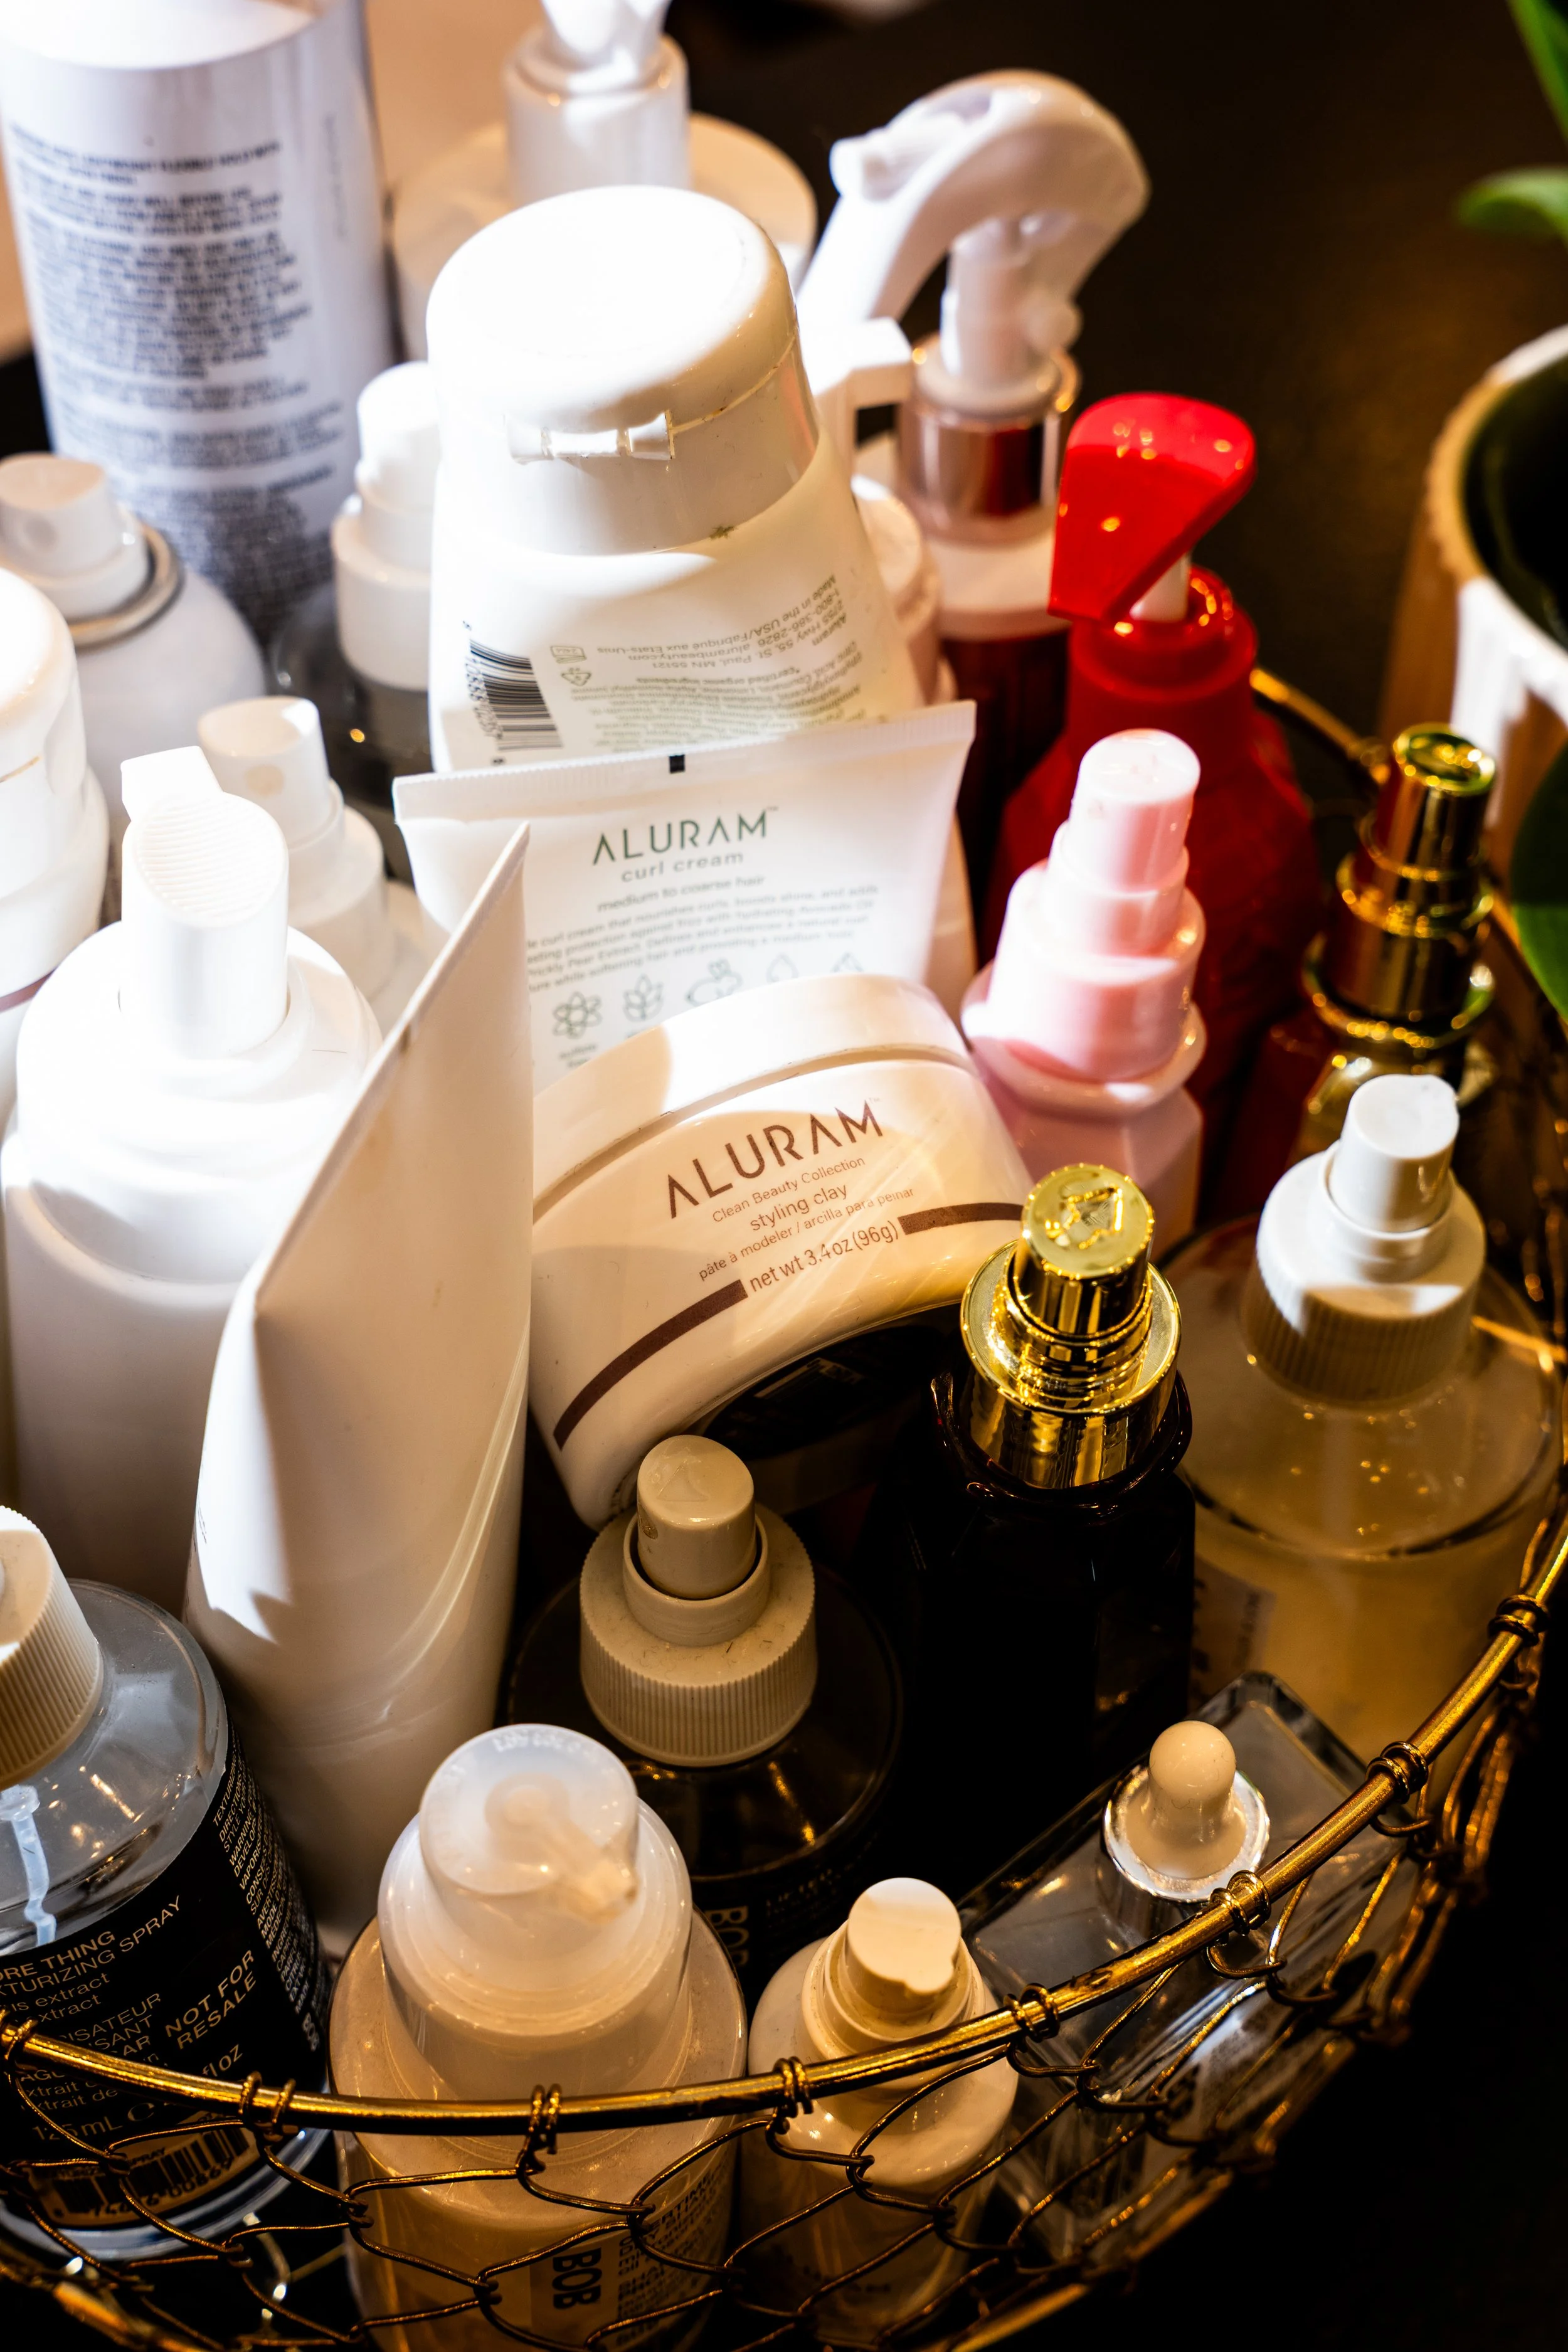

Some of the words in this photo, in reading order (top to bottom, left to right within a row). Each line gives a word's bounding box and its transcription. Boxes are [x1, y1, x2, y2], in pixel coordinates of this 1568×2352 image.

[801, 598, 812, 609] in
[812, 575, 835, 600] Made
[782, 607, 800, 622] the
[812, 613, 847, 646] Aluram
[621, 861, 664, 882] curl
[673, 852, 744, 872] cream
[597, 890, 659, 913] medium
[661, 886, 678, 898] to
[679, 877, 732, 894] coarse
[735, 874, 766, 887] hair
[712, 1198, 750, 1223] Clean
[752, 1179, 798, 1205] Beauty
[801, 1157, 866, 1184] Collection
[750, 1197, 810, 1231] styling
[813, 1184, 847, 1205] clay
[698, 1258, 727, 1282] pâte
[729, 1251, 738, 1263] à
[740, 1226, 793, 1258] modeler
[805, 1209, 843, 1230] arcilla
[845, 1198, 874, 1217] para
[750, 1266, 780, 1292] net
[779, 1255, 805, 1277] wt
[119, 1895, 182, 1953] SPRAY
[40, 1931, 117, 1970] THING
[34, 1973, 110, 2008] extract
[38, 1994, 102, 2023] xtract
[164, 1993, 211, 2038] NOT
[217, 1949, 255, 1999] FOR
[176, 1970, 257, 2050] RESALE
[553, 2247, 602, 2310] BOB
